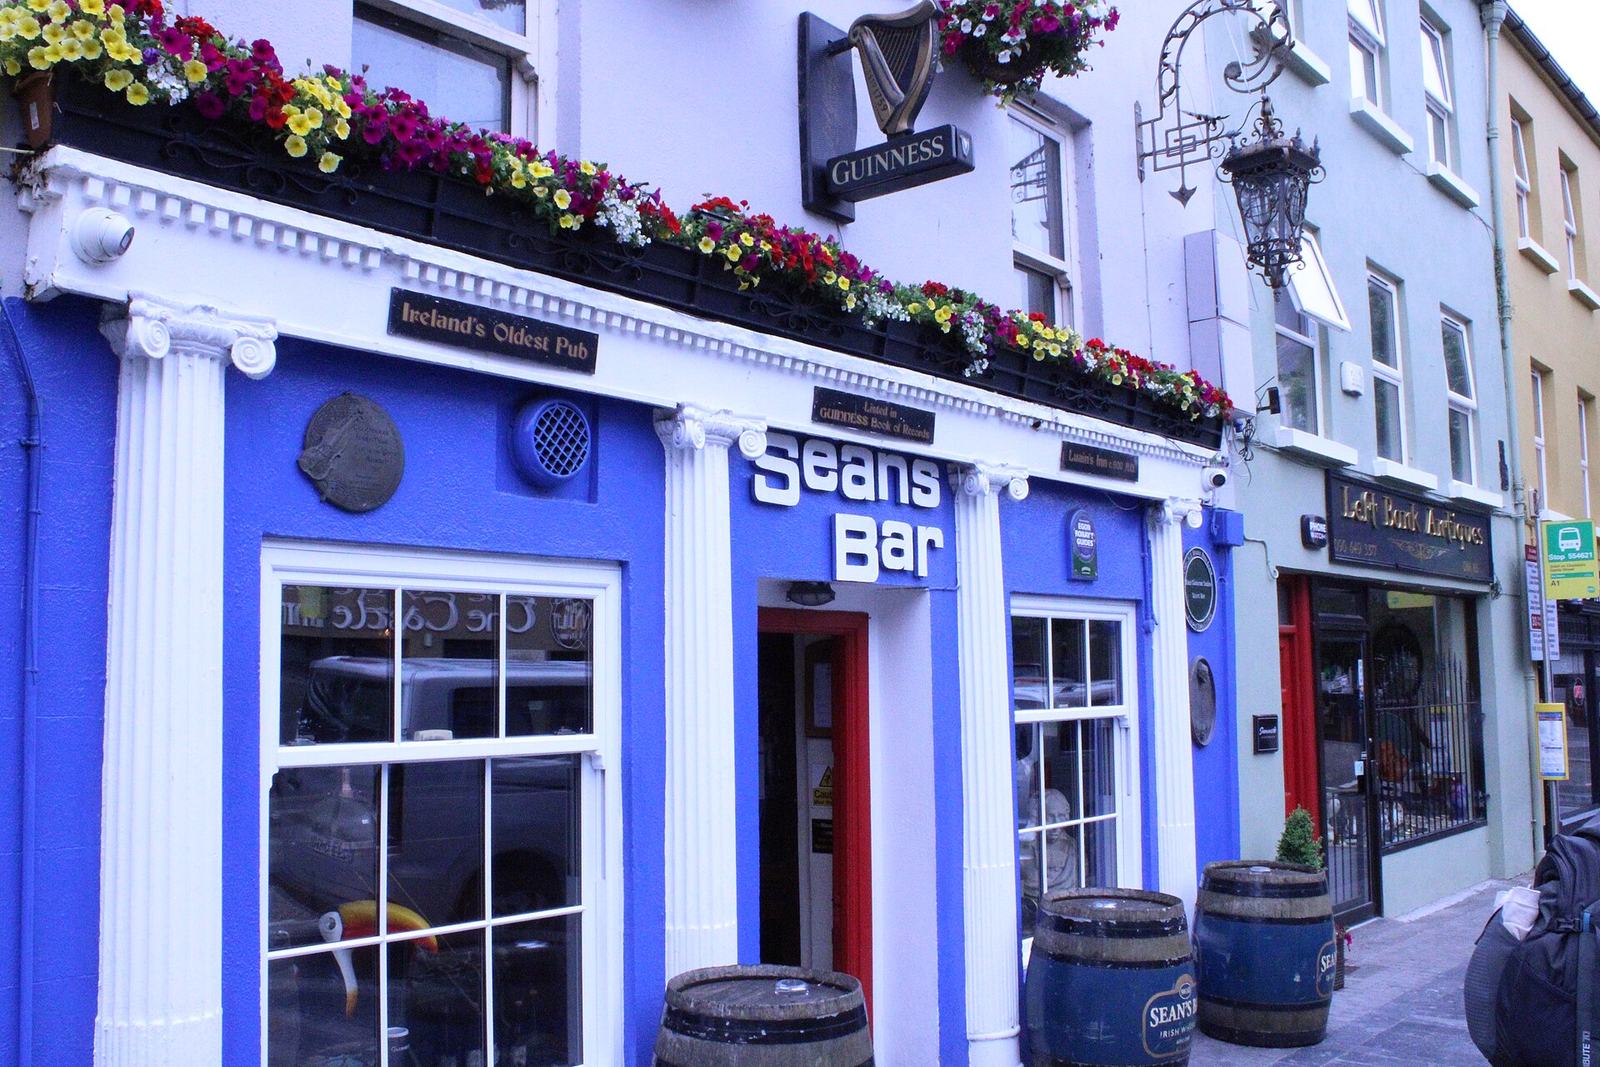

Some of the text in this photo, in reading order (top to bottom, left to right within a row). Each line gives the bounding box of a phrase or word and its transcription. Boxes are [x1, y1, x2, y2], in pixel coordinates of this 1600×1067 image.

[832, 135, 944, 185] GUINNESS
[403, 302, 588, 360] Ireland's Oldest Pub
[819, 407, 930, 439] GUINNESS Book of Records
[864, 401, 898, 418] Listed in
[754, 432, 941, 508] Seans
[1340, 485, 1378, 529] Left
[1383, 495, 1421, 532] Bank
[1425, 506, 1484, 550] Antiques
[835, 512, 944, 583] Bar
[1149, 1000, 1192, 1027] SEAN'S
[1160, 1028, 1180, 1038] IRISH
